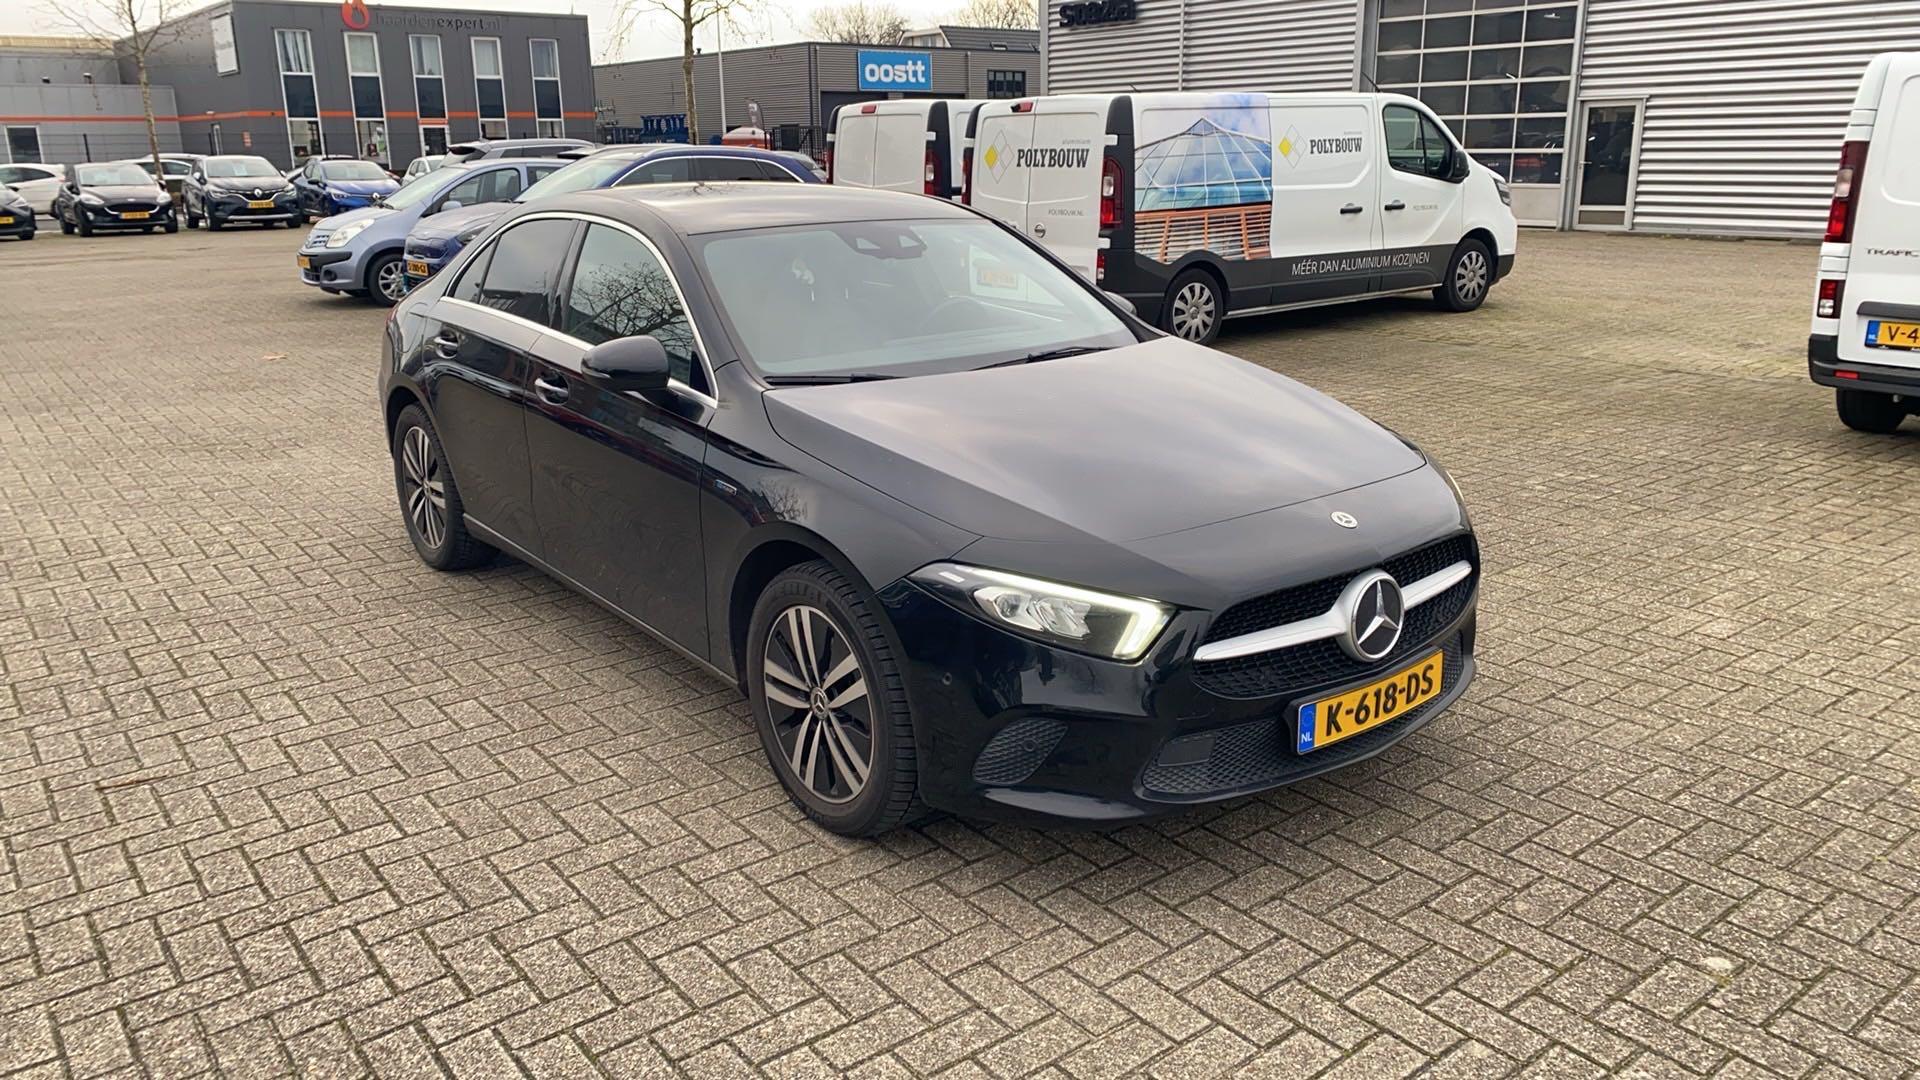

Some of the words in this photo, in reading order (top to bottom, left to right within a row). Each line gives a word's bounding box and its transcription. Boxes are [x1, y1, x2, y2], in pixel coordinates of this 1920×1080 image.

[864, 60, 926, 83] oostt
[1310, 137, 1362, 154] POLYBOUW
[1016, 148, 1089, 168] POLYBOUW
[1866, 247, 1920, 257] TRAFIC
[1291, 258, 1317, 275] MÉÉR
[1320, 260, 1339, 273] DAN
[1340, 255, 1391, 271] ALUMINIUM
[1392, 251, 1430, 267] KOZIJNEN
[1326, 664, 1434, 736] K-618-DS
[1301, 731, 1313, 743] NL
